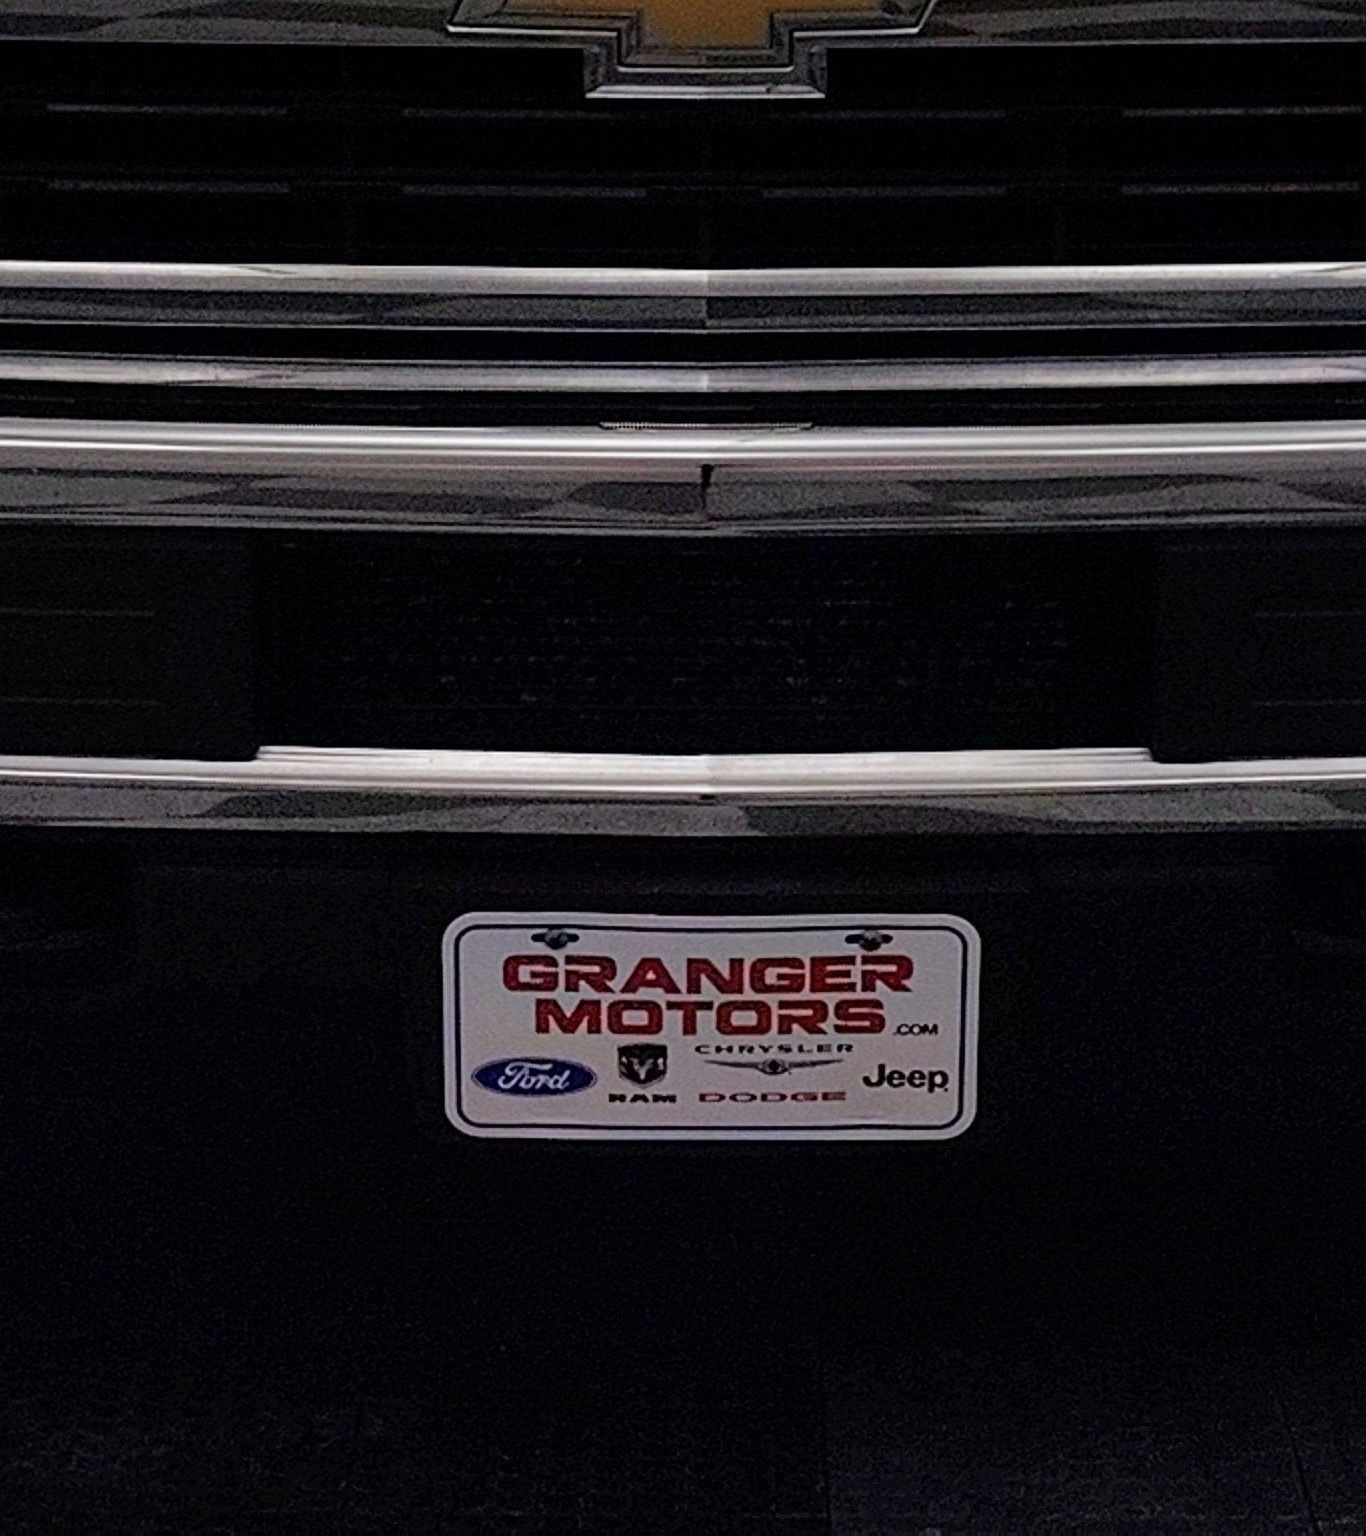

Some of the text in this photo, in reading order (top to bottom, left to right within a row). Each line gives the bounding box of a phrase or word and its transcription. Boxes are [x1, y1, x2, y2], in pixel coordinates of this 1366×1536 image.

[502, 953, 914, 995] GRANGER
[535, 999, 885, 1035] MOTORS
[694, 1043, 854, 1054] CHRYSLER
[496, 1062, 571, 1092] Ford
[862, 1063, 949, 1093] Jeep
[608, 1092, 677, 1103] RAM
[698, 1090, 847, 1103] DODGE
